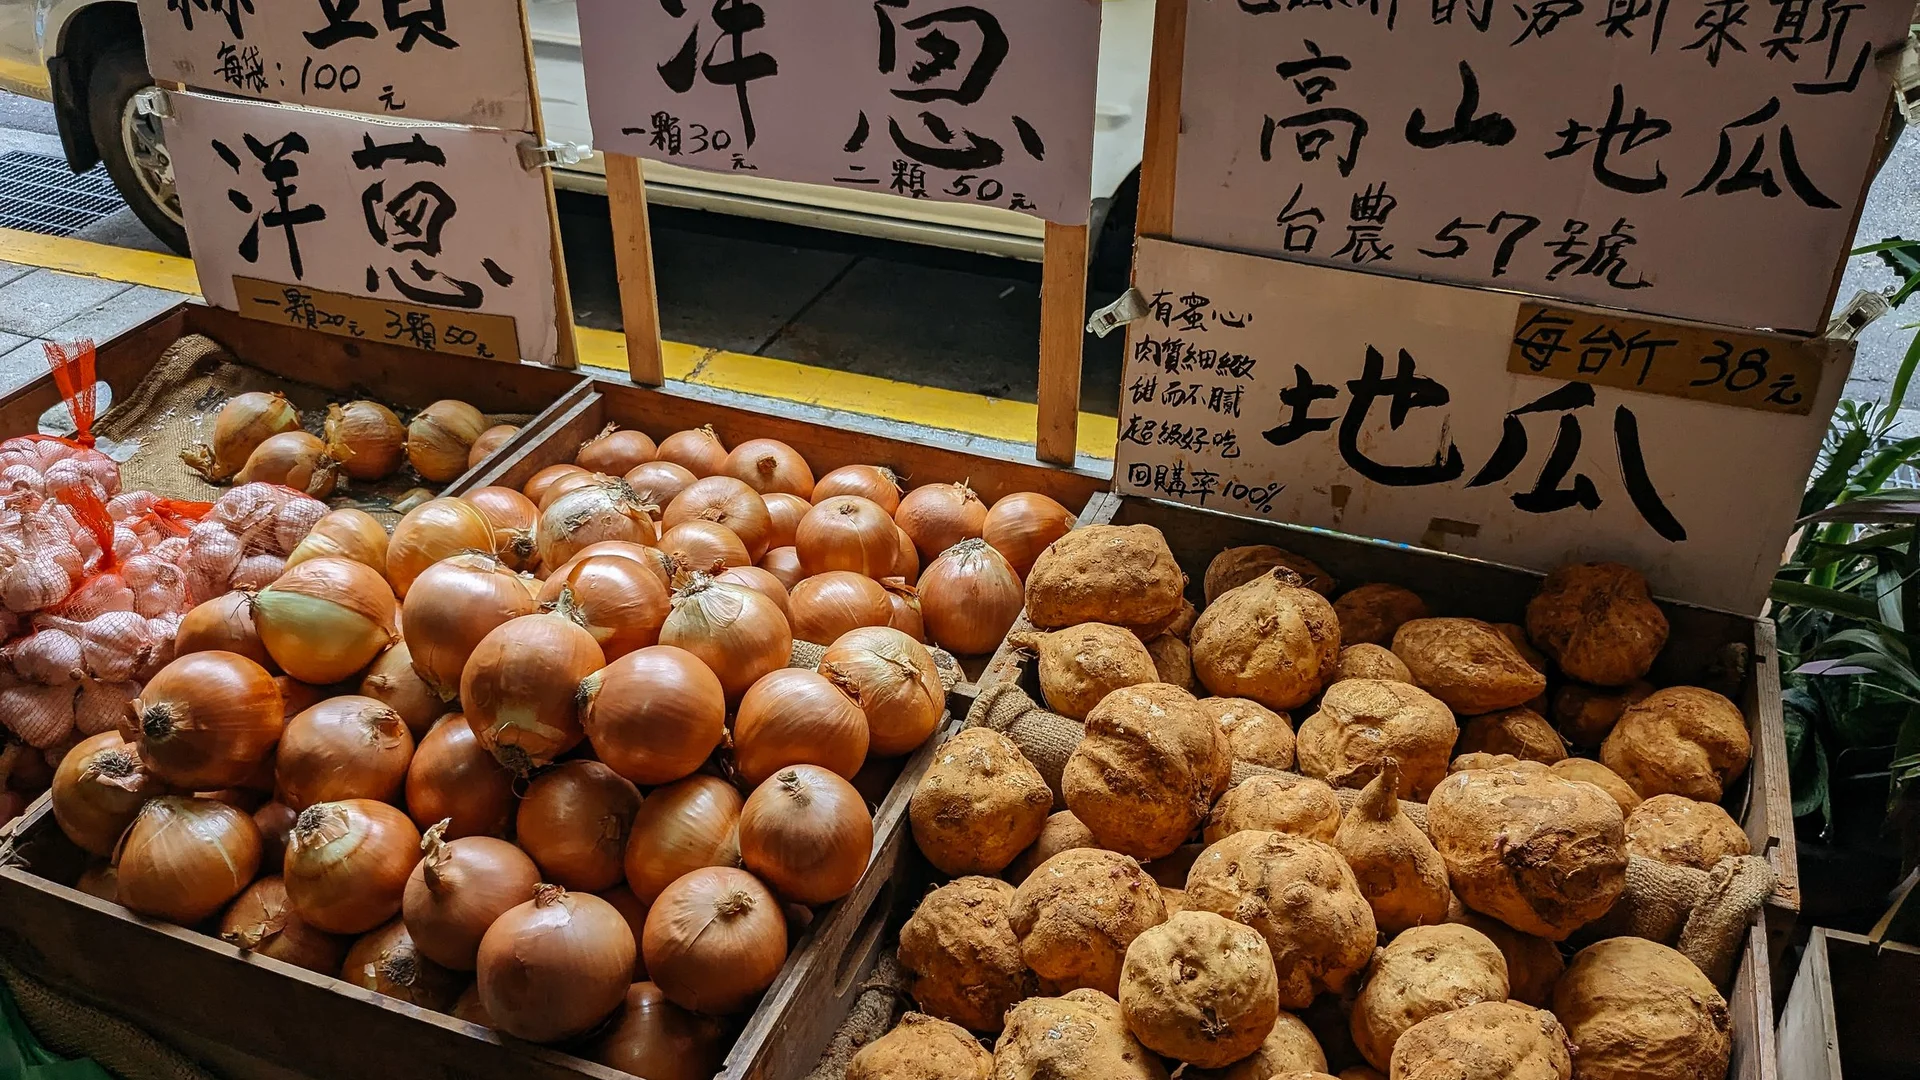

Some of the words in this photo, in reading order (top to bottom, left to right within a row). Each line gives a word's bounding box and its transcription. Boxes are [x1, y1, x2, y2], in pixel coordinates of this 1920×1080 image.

[1261, 39, 1843, 209] 高山地瓜
[212, 132, 513, 308] 洋蔥
[1149, 289, 1253, 332] 有蜜心
[1134, 334, 1257, 381] 肉質細緻
[1129, 375, 1245, 418] 甜而不膩
[1121, 413, 1241, 459] 超級好吃
[1262, 347, 1687, 542] 地瓜
